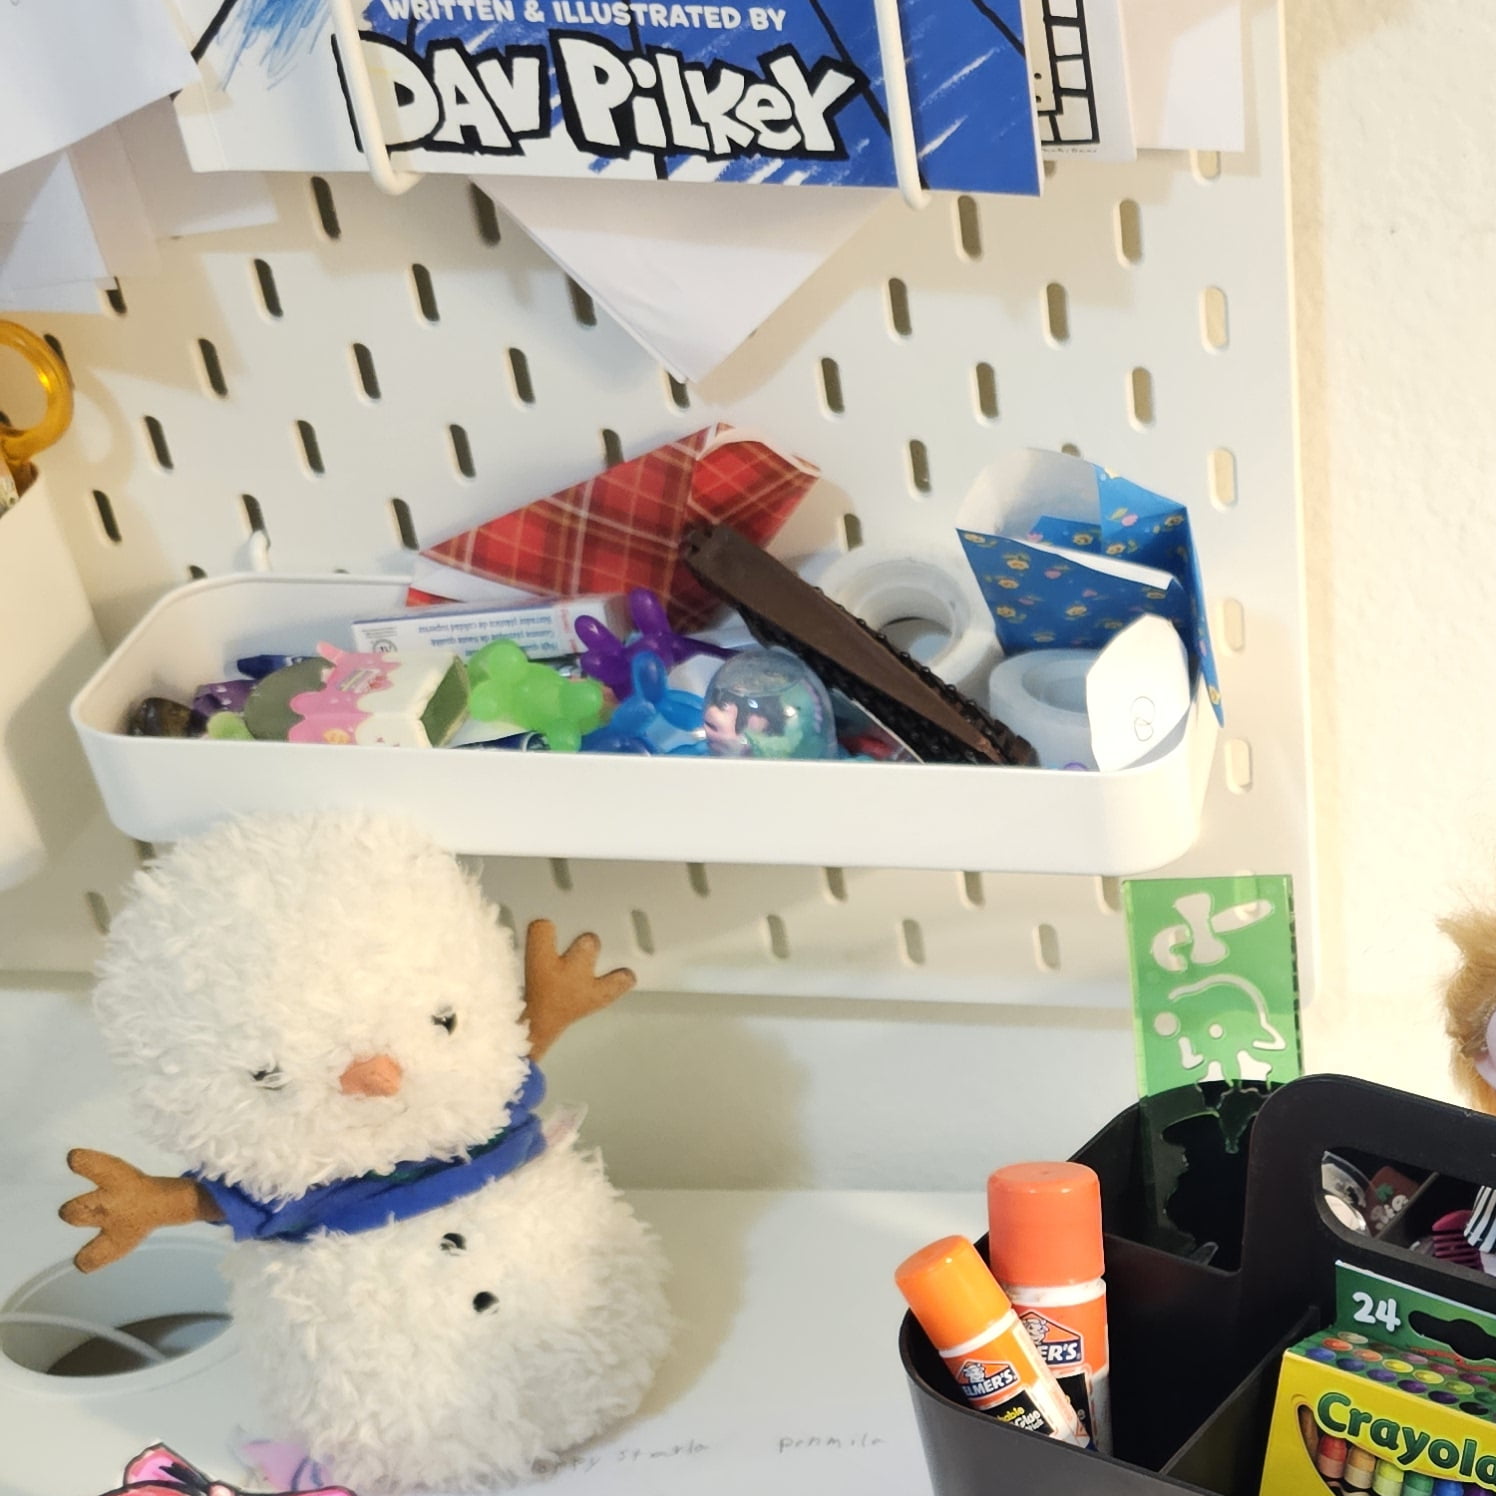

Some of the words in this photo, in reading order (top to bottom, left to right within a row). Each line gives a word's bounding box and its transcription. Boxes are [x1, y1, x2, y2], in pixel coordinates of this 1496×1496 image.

[382, 0, 515, 21] WRITTEN
[523, 0, 545, 23] &
[552, 1, 742, 29] ILLUSTRATED
[749, 7, 786, 32] BY
[340, 33, 547, 152] DAV
[1352, 1291, 1401, 1332] 24
[1039, 1342, 1078, 1361] ER'S
[961, 1368, 1014, 1397] ELMER'S
